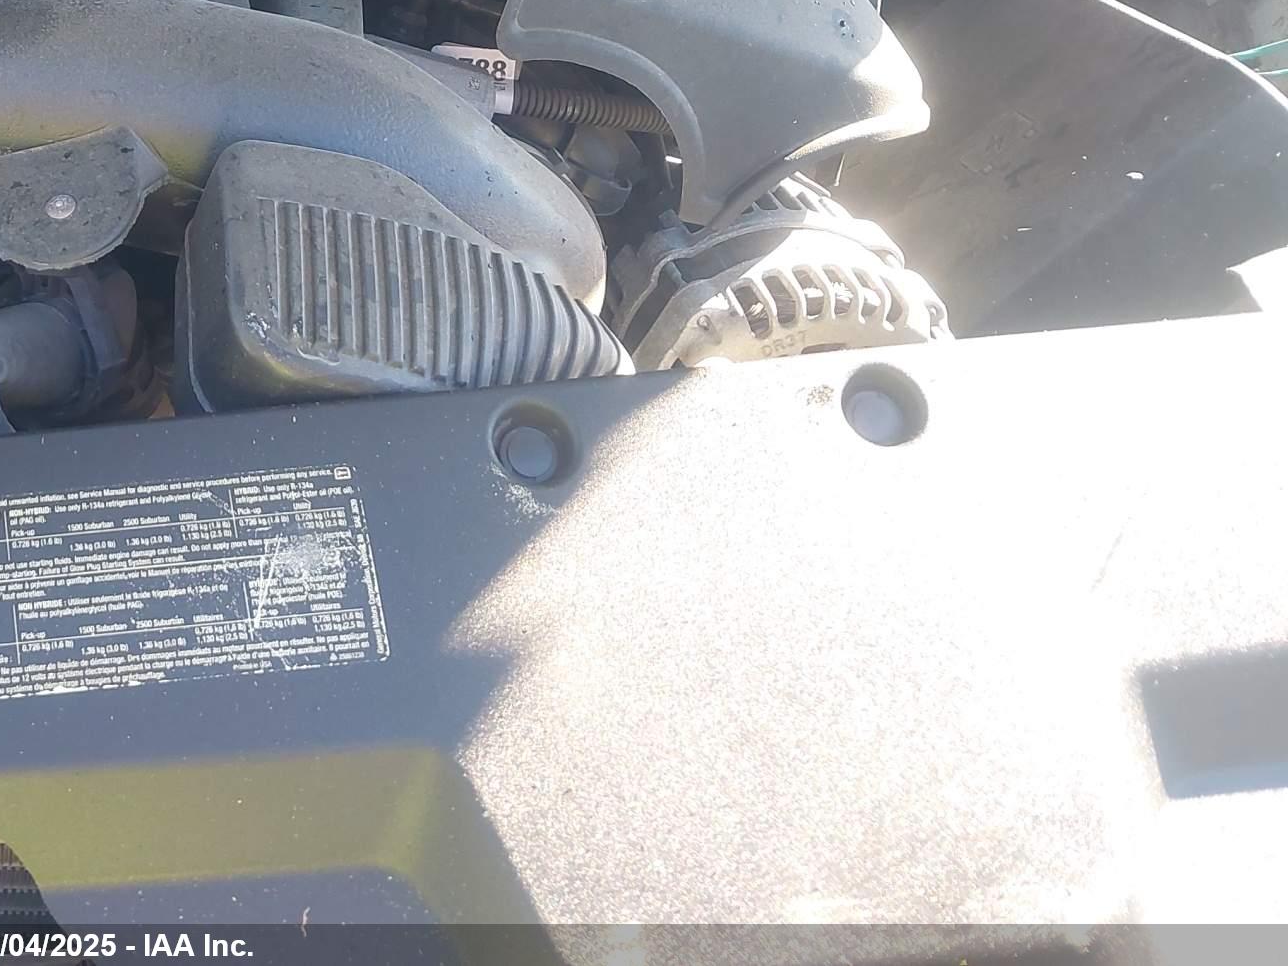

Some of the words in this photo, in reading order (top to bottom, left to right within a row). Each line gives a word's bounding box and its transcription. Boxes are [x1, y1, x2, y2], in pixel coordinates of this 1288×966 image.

[8, 496, 38, 506] unwanted
[67, 492, 78, 500] see
[79, 490, 102, 499] Service
[103, 488, 126, 497] Manual
[127, 487, 136, 495] for
[136, 484, 168, 494] diagnostic
[169, 483, 181, 491] and
[182, 481, 204, 490] service
[205, 478, 240, 488] procedures
[240, 476, 260, 485] before
[261, 472, 295, 483] performing
[296, 471, 307, 479] any
[54, 504, 66, 513] Use
[67, 503, 80, 512] only
[81, 501, 105, 511] R-134a
[122, 518, 139, 526] 2500
[139, 515, 170, 524] Suburban
[178, 512, 197, 521] Utility
[67, 523, 83, 531] 1500
[84, 520, 114, 529] Suburban
[11, 527, 35, 537] Pick-up
